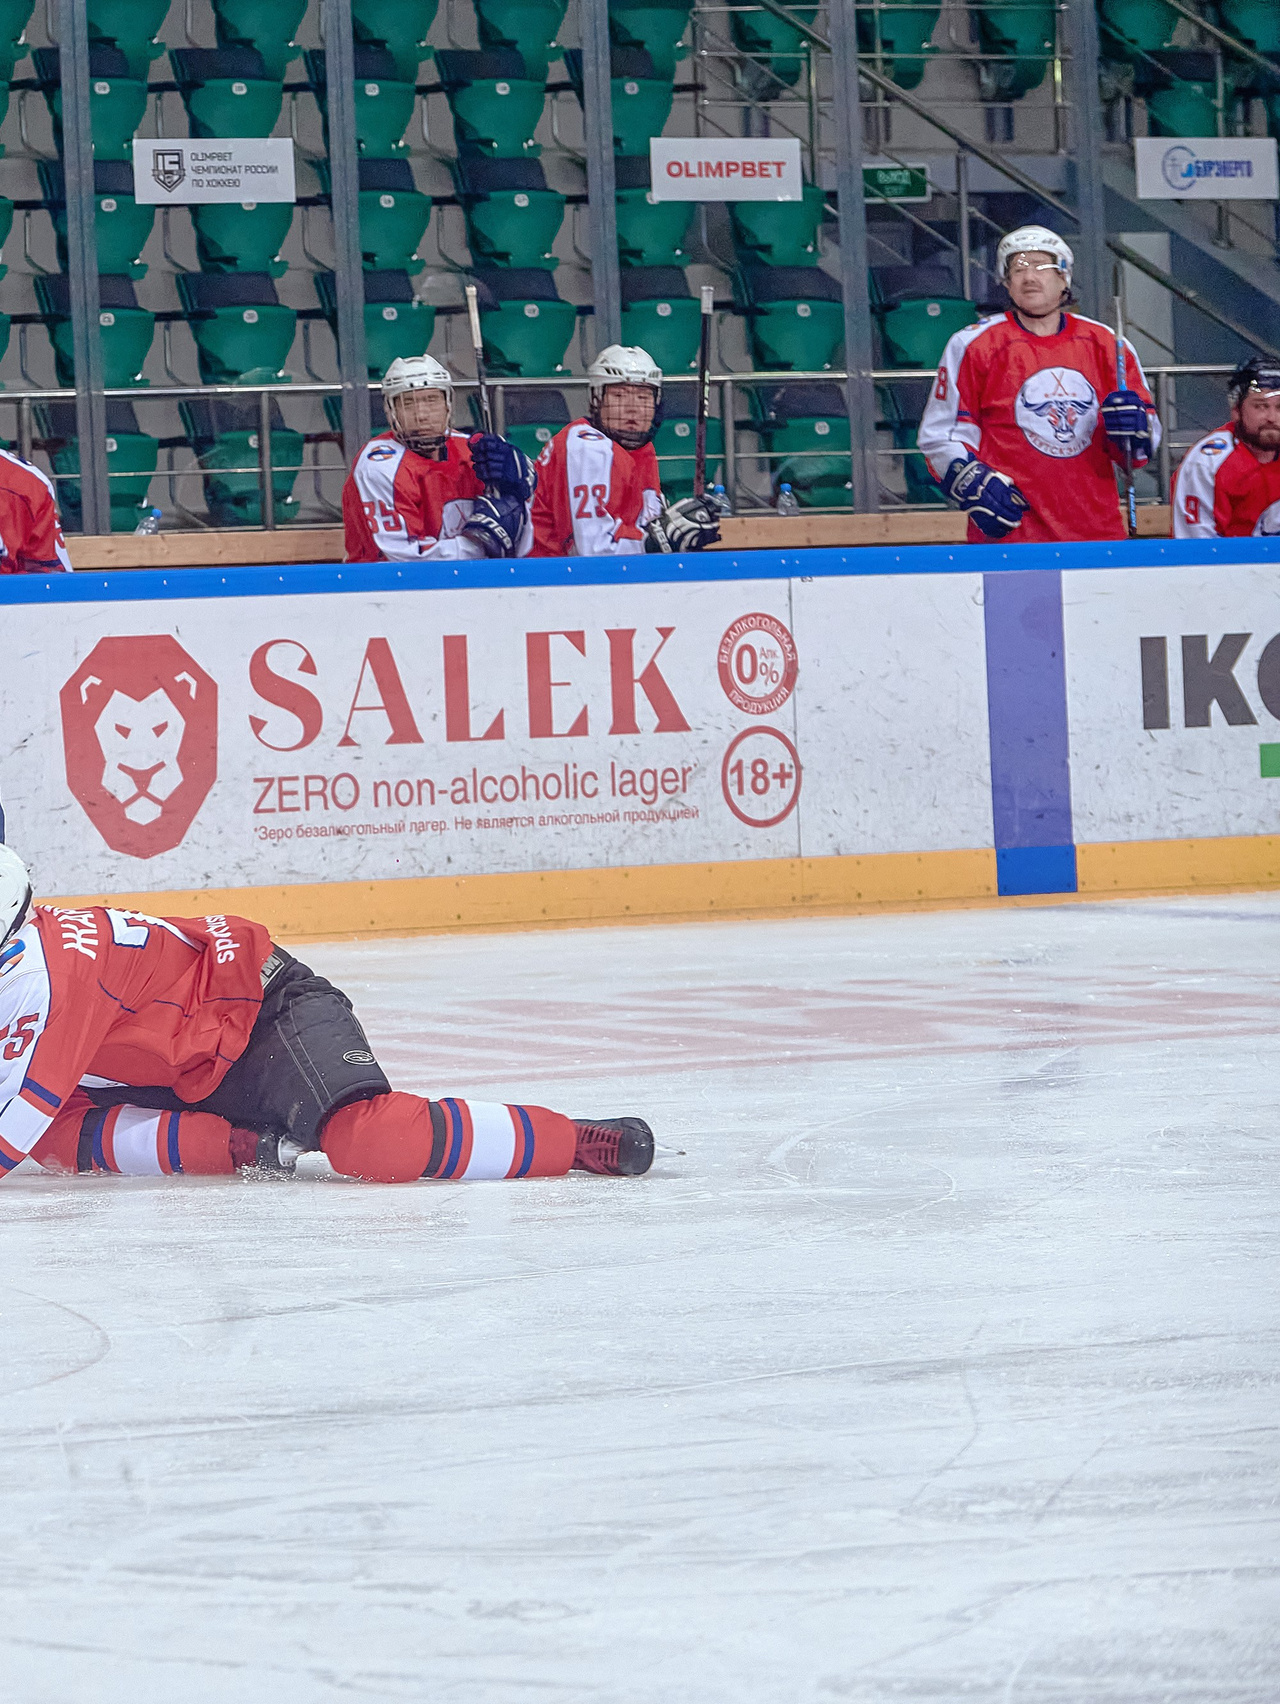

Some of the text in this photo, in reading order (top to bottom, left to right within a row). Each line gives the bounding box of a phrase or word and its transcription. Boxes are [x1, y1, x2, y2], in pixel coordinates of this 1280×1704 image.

[191, 152, 233, 162] OLIMPBET
[191, 165, 279, 175] ЧЕМПИОНАТ РОССИИ
[666, 161, 787, 179] OLIMPBET
[192, 178, 241, 188] ПО ХОККЕЮ
[718, 615, 797, 664] БЕЗАЛКОГОЛЬНАЯ
[248, 626, 693, 752] SALEK
[728, 686, 790, 713] ПРОДУКЦИЯ
[252, 772, 362, 814] ZERO
[373, 763, 599, 808] non-alcoholic
[730, 758, 793, 796] 18+
[296, 819, 406, 839] безалкогольный
[410, 818, 450, 835] лагер.
[455, 816, 472, 831] Не
[476, 813, 535, 829] является
[539, 809, 620, 827] алкогольной
[624, 806, 699, 825] продукцией
